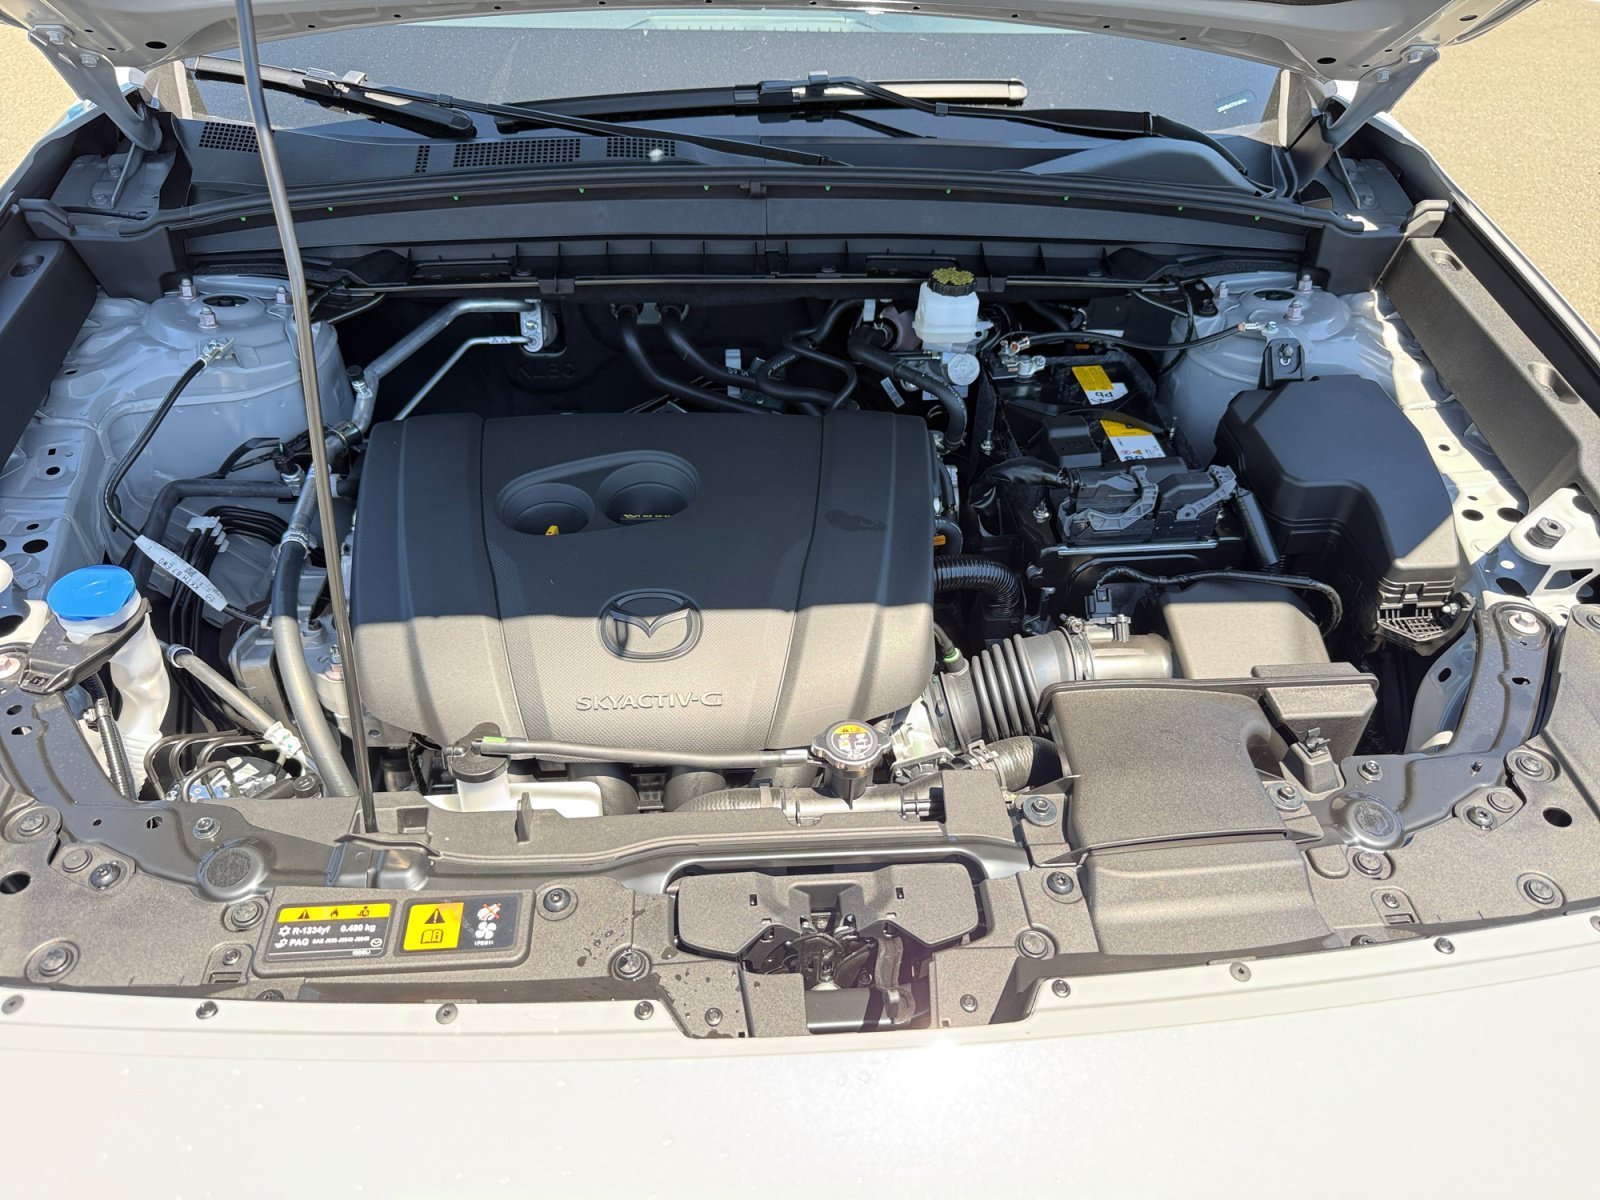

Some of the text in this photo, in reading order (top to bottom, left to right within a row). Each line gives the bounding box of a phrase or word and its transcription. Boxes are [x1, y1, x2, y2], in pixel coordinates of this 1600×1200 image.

[575, 691, 723, 711] SKYACTIV-G
[364, 923, 376, 933] kg
[289, 938, 309, 947] PAG
